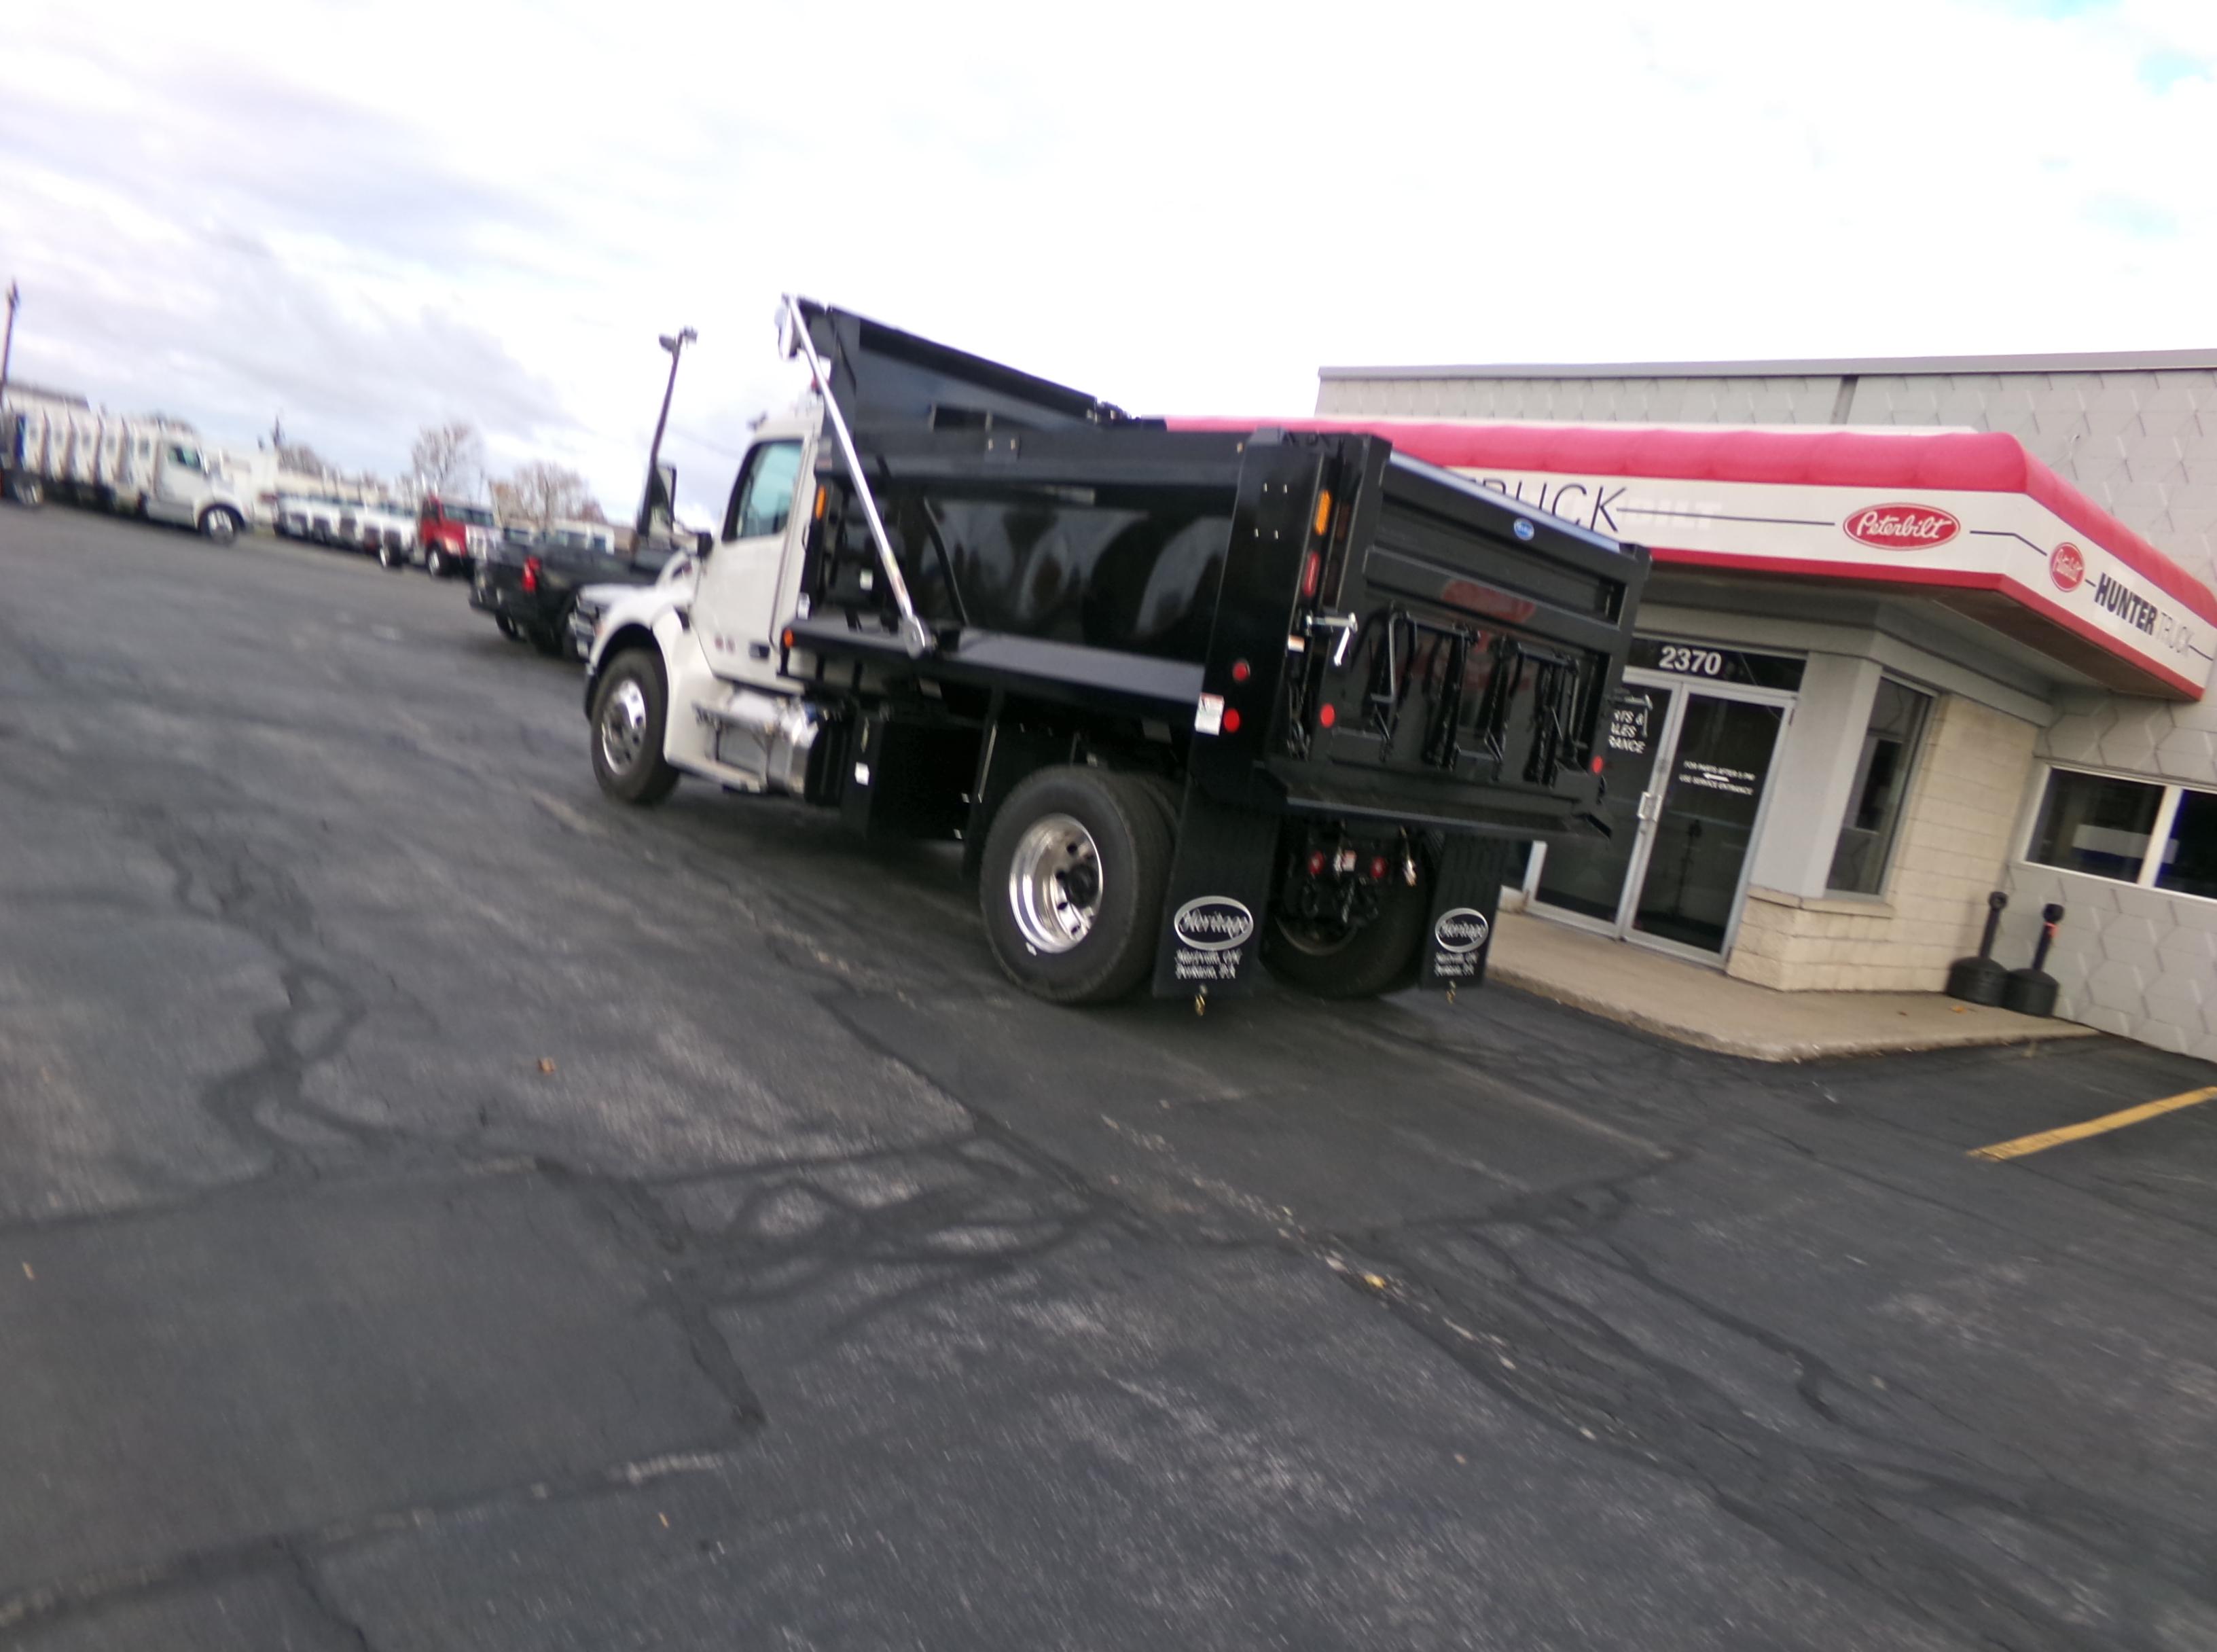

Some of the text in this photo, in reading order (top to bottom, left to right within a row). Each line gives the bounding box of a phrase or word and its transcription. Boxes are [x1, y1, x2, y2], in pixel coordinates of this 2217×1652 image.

[1856, 510, 1952, 539] Peterbilt
[2094, 572, 2159, 636] HUNTER
[1659, 646, 1722, 675] 2370
